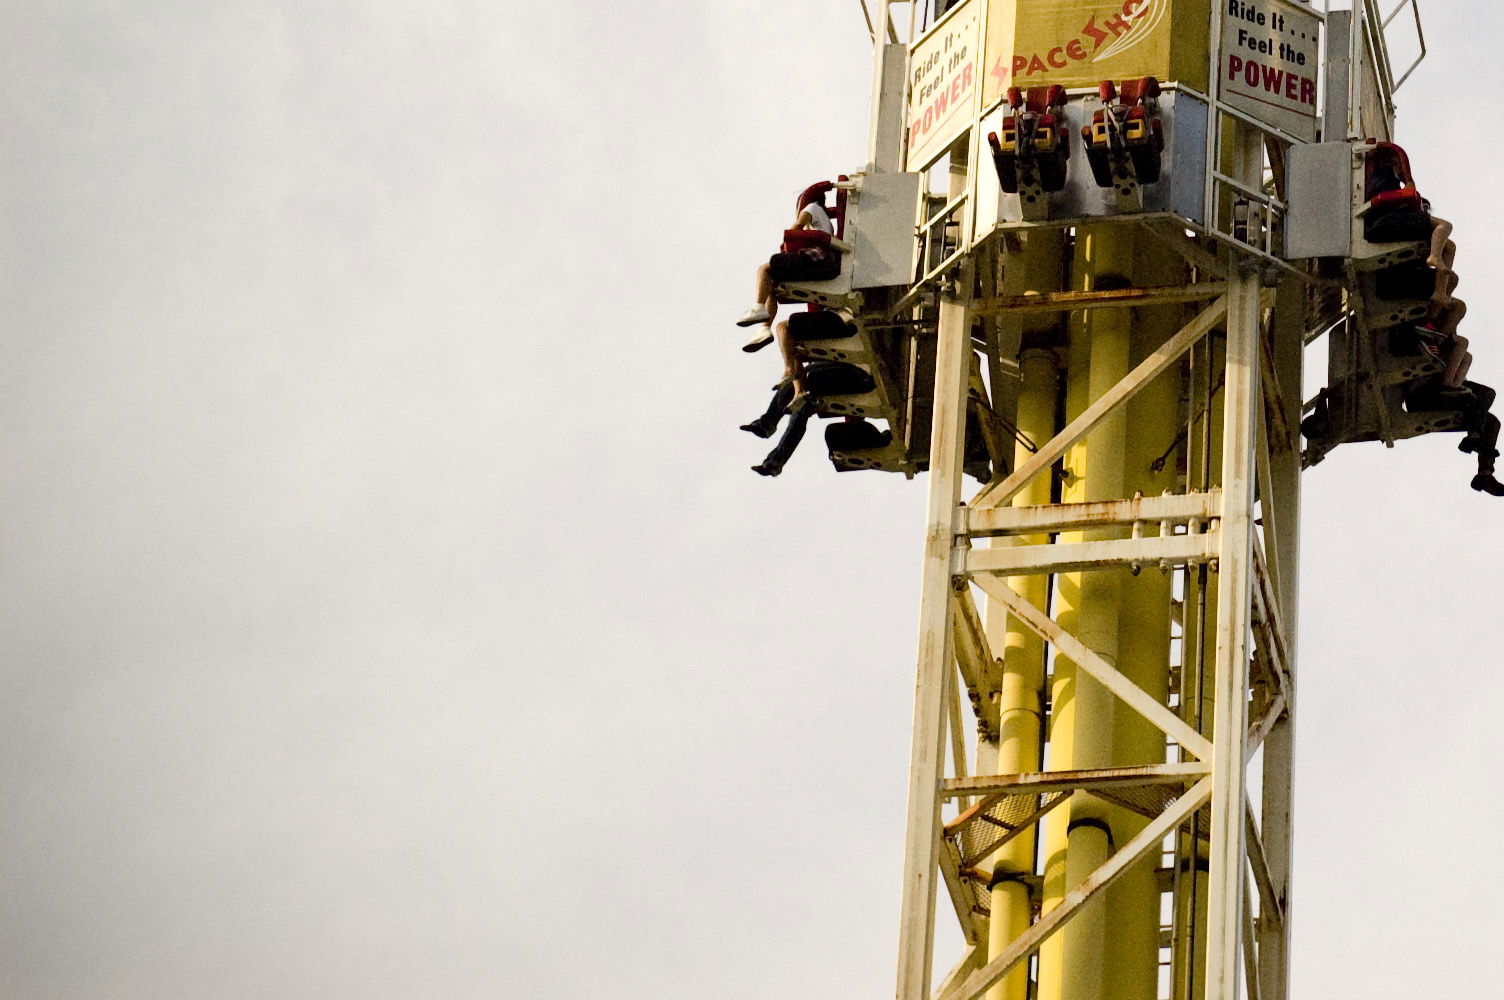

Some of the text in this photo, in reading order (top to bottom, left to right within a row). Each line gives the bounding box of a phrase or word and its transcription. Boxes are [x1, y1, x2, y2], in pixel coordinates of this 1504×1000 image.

[1238, 28, 1306, 66] Feel the
[1272, 12, 1285, 32] It
[914, 50, 940, 87] Ride
[944, 32, 953, 54] It
[919, 45, 967, 106] Feel the
[1228, 54, 1315, 106] POWER
[911, 62, 973, 149] POWER
